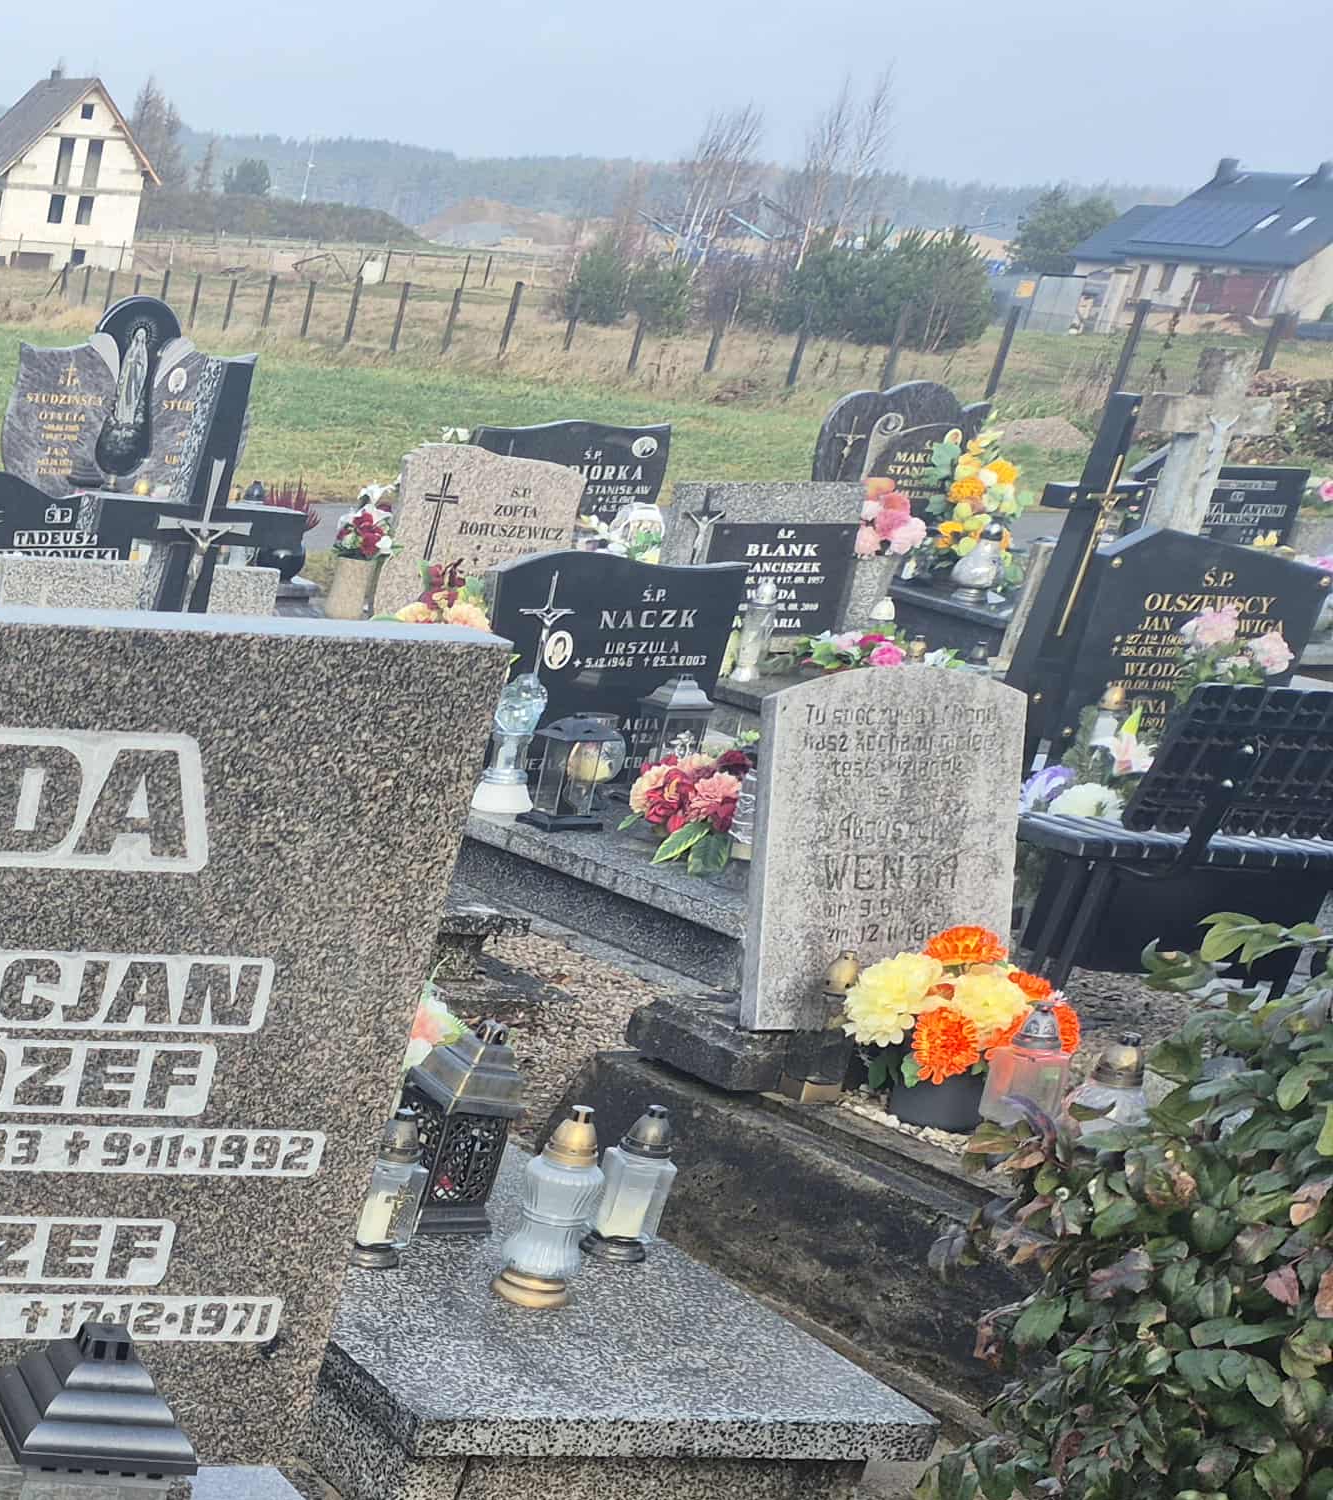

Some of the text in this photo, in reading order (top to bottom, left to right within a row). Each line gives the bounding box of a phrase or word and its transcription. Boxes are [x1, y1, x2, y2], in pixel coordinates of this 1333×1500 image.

[16, 531, 96, 546] TADEUSZ
[458, 521, 565, 541] BOHUSZEWICZ
[745, 544, 820, 557] BLANK
[748, 562, 821, 573] ANCISZEK
[598, 609, 698, 630] NACZK
[1139, 616, 1174, 631] JAN
[605, 640, 680, 655] URSZULA
[823, 854, 959, 891] WENTA
